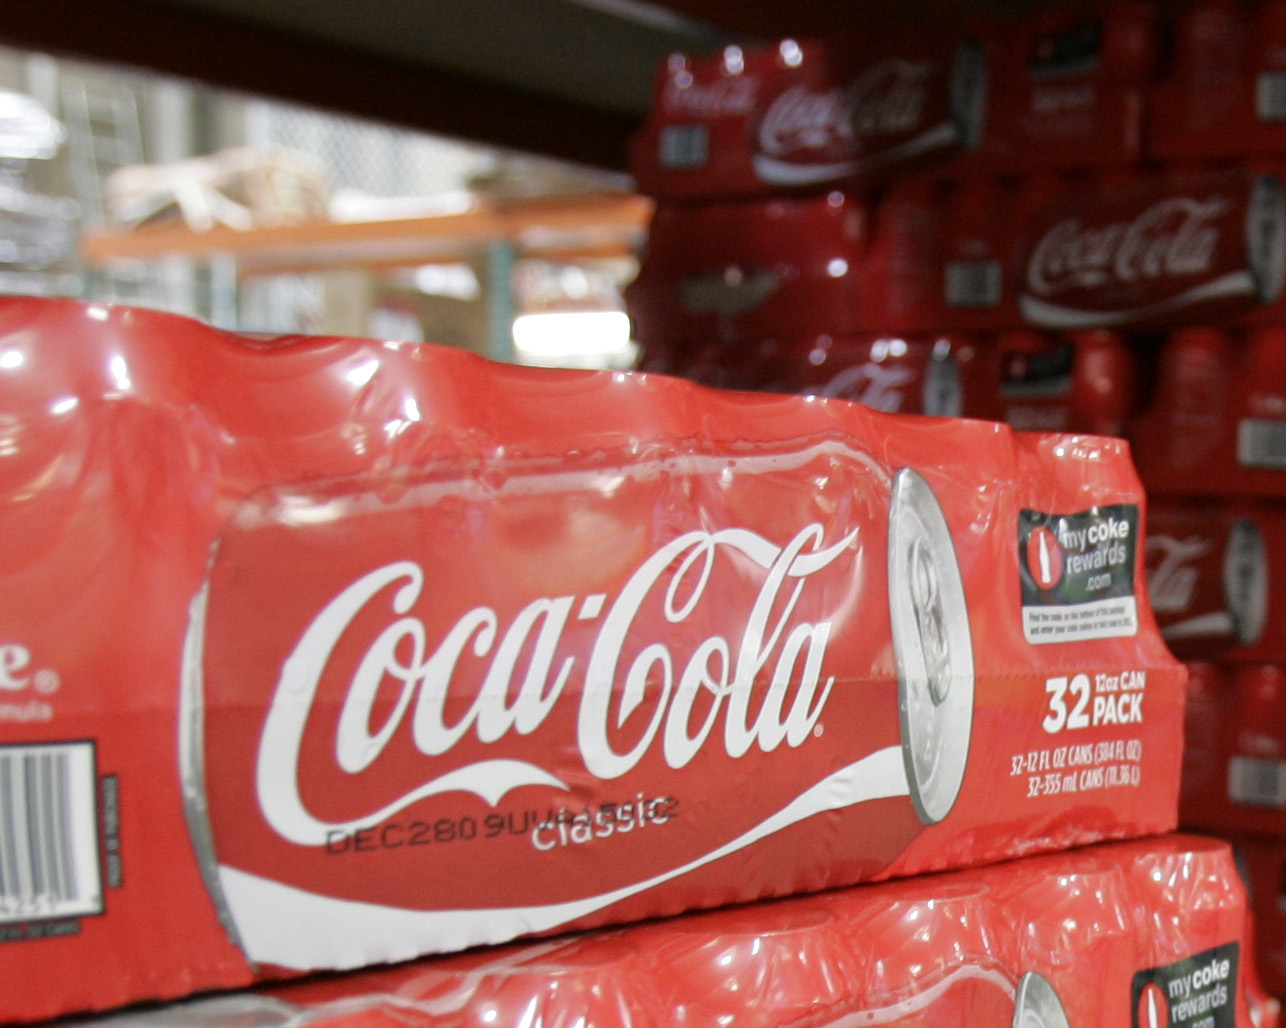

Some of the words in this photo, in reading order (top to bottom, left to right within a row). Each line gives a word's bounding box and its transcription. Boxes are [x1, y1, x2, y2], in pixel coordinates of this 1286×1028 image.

[1066, 540, 1127, 575] rewards
[256, 523, 859, 846] Coca-Cola
[1120, 671, 1147, 691] CAN
[1042, 673, 1091, 734] 32
[1092, 692, 1144, 726] PACK
[1068, 743, 1095, 767] CANS
[1080, 766, 1105, 791] CANS
[532, 793, 671, 851] classic
[1170, 982, 1228, 1024] rewards
